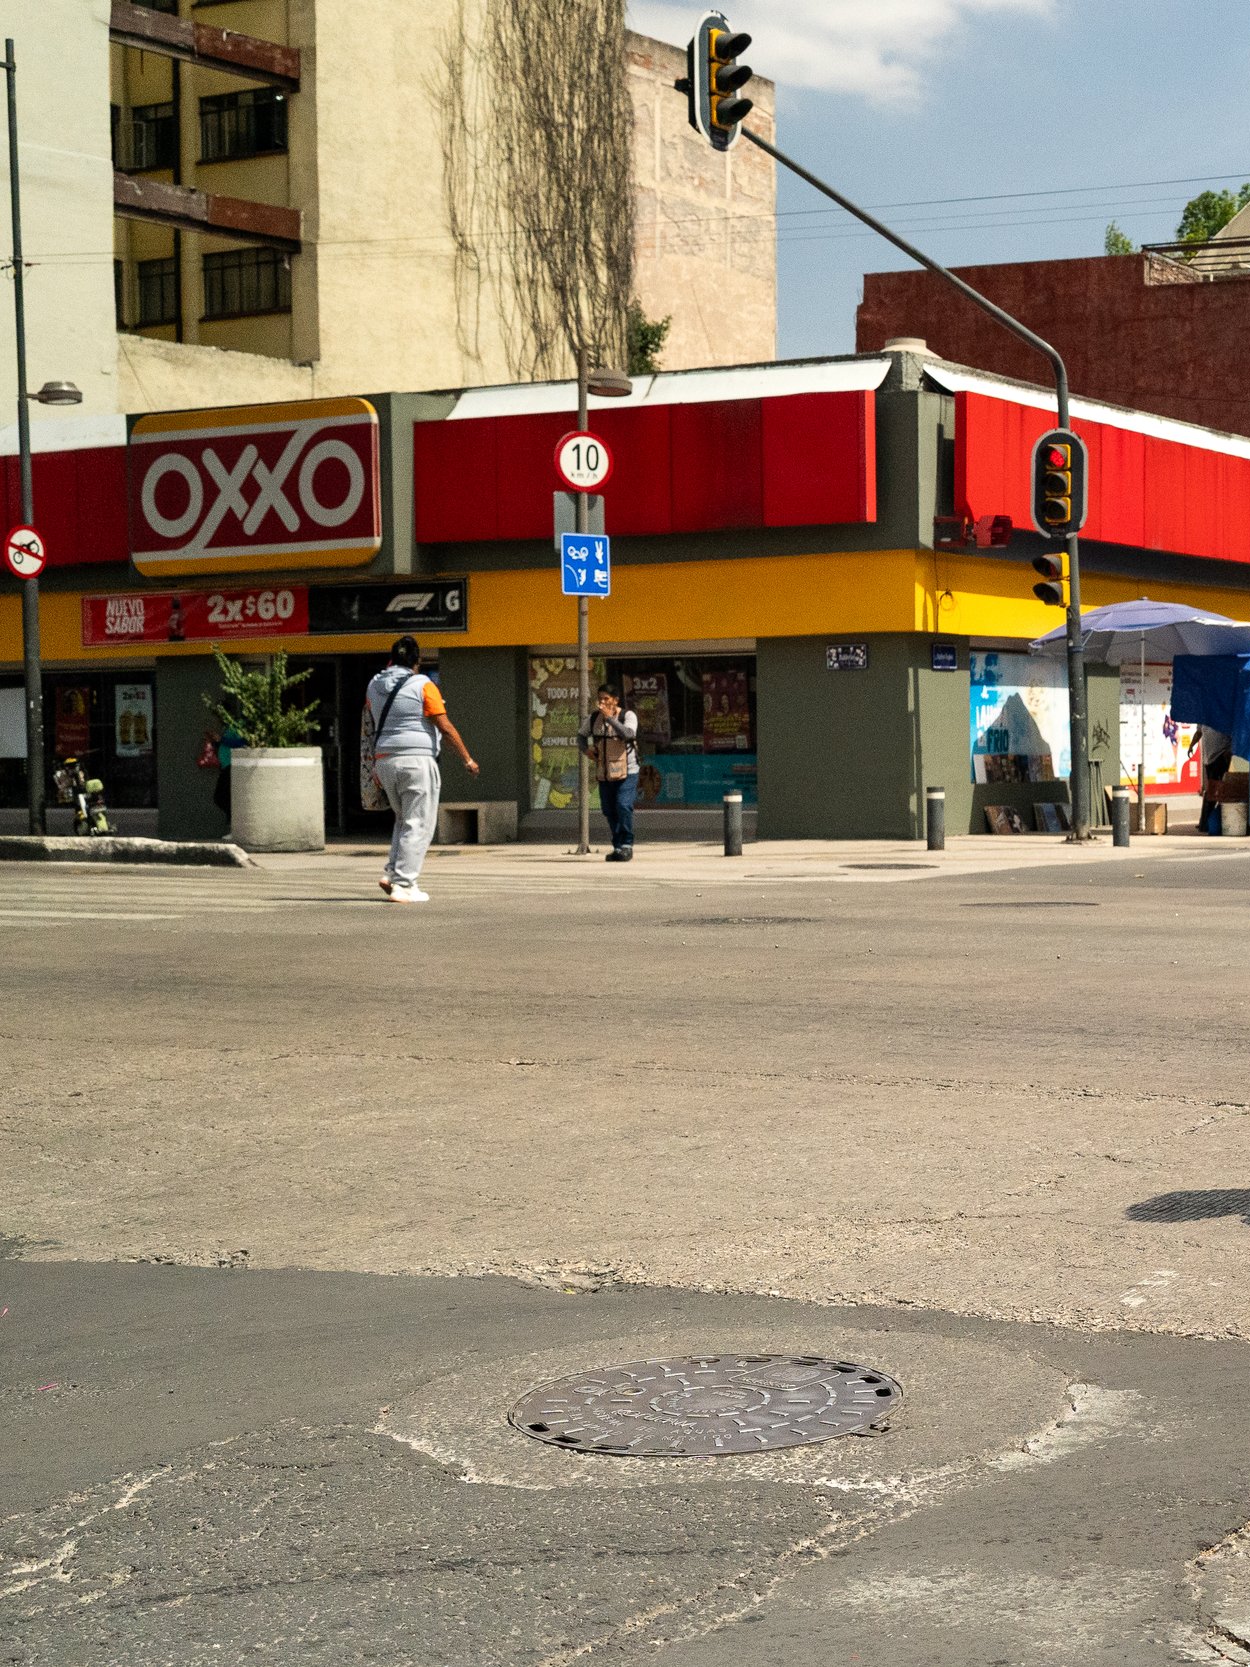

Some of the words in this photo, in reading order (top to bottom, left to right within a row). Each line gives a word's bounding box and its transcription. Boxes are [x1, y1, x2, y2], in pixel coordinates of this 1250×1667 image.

[571, 444, 599, 471] 10
[141, 438, 365, 541] OXXO
[105, 599, 145, 617] NUEVO
[105, 616, 145, 634] SABOR
[633, 677, 658, 690] 3x2
[546, 687, 568, 699] TODO
[542, 737, 568, 747] SIEMPRE
